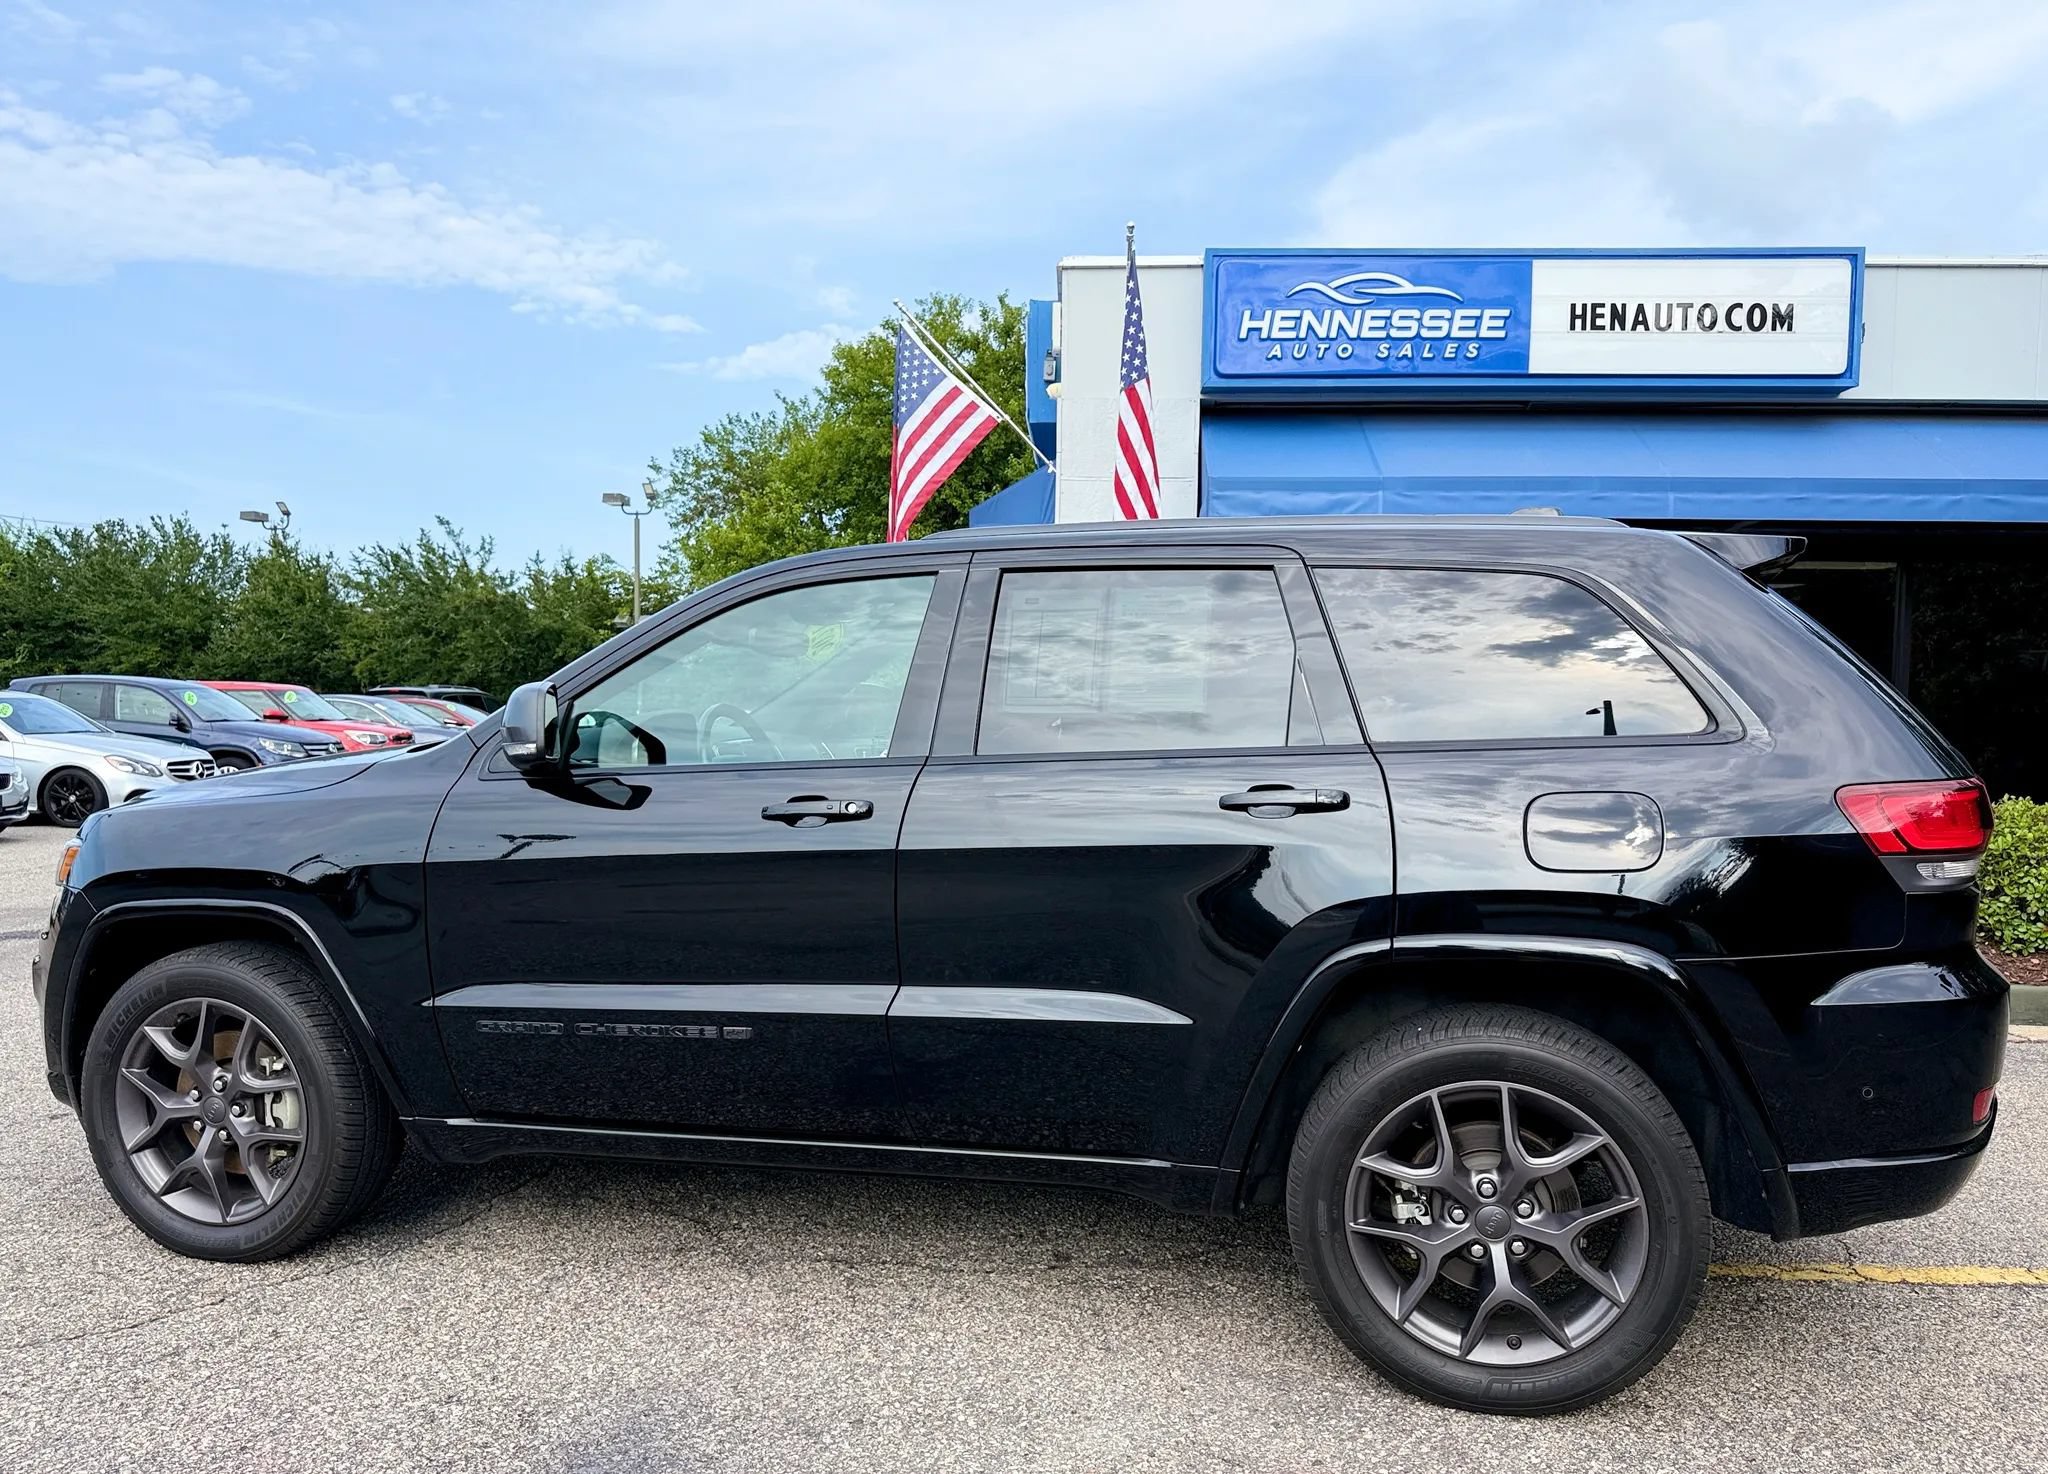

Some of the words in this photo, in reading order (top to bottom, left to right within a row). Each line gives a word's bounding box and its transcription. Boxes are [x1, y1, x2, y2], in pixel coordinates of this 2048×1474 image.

[1239, 308, 1511, 340] HENNESSEE
[1568, 302, 1795, 333] HENAUTO.COM
[1266, 343, 1354, 360] AUTO
[1376, 343, 1480, 360] SALES
[103, 982, 167, 1049] MICHELIN
[574, 1022, 718, 1039] CHEROKEE
[240, 1182, 309, 1249] MICHELIN
